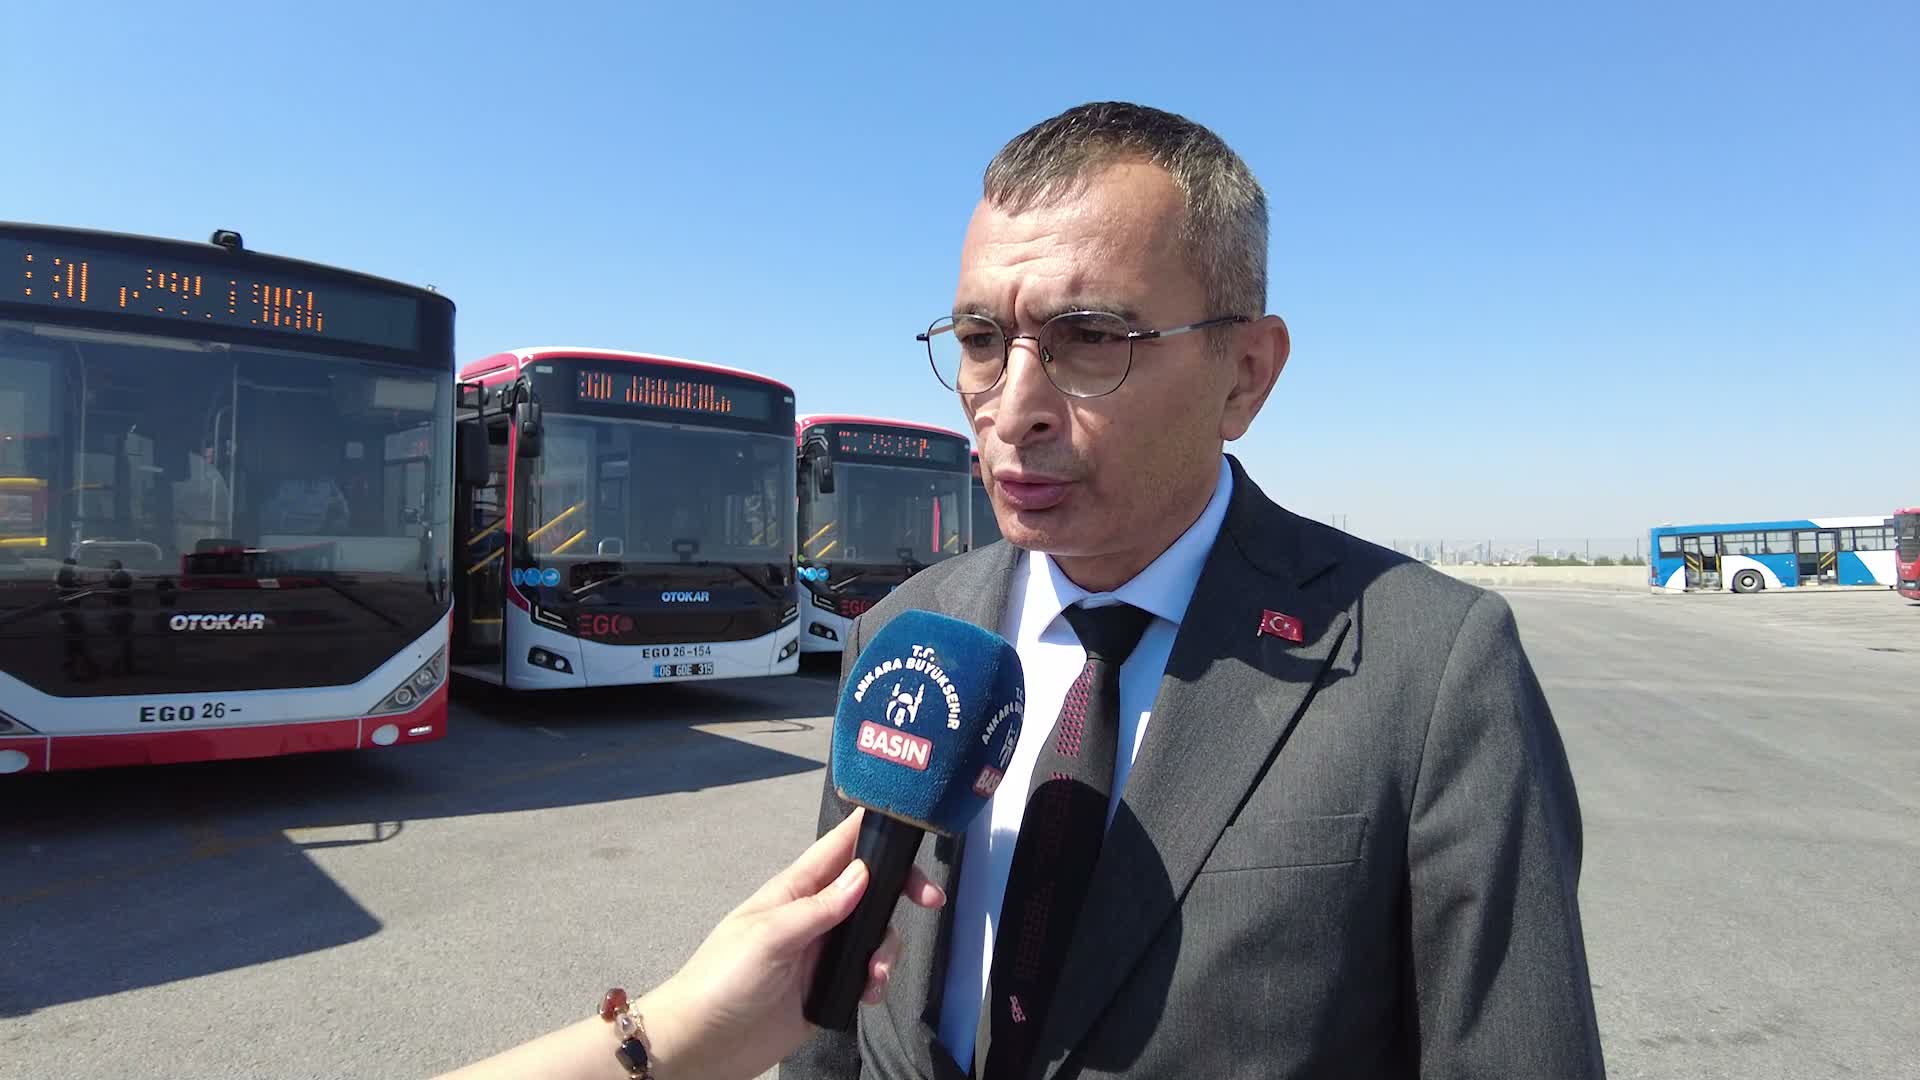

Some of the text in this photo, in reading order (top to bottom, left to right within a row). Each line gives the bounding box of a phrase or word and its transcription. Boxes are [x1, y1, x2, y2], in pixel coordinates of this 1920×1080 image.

[661, 591, 709, 602] OTOKAR
[169, 613, 265, 631] OTOKAR
[642, 646, 711, 658] EGO 26-154
[698, 663, 713, 675] 315
[854, 658, 903, 703] ANKARA
[139, 706, 195, 722] EGO
[860, 726, 928, 765] BASIN
